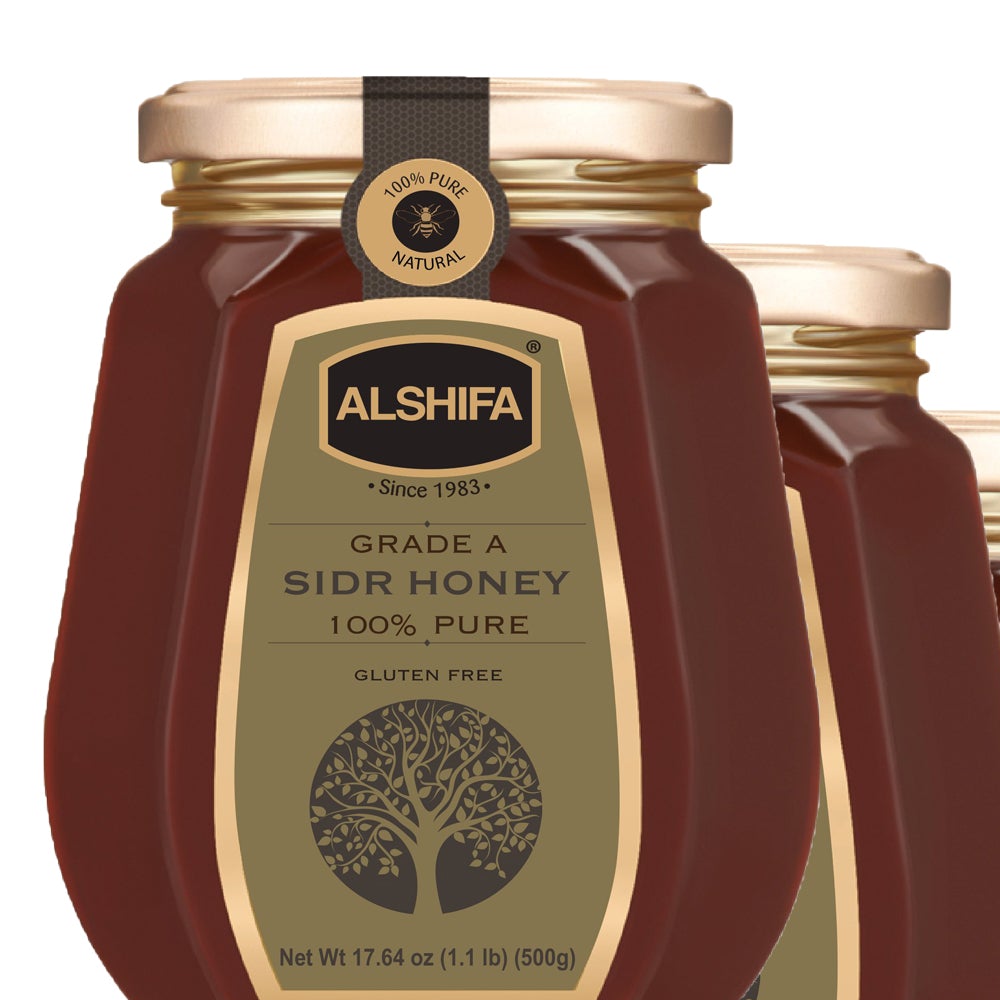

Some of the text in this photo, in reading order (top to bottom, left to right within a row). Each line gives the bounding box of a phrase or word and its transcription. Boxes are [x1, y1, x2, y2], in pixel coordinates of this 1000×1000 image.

[384, 171, 469, 200] 100% PURE
[391, 249, 466, 271] NATURAL
[335, 385, 523, 422] ALSHIFA
[378, 478, 481, 499] Since 1983
[350, 534, 508, 554] GRADE A
[283, 570, 571, 596] SIDR HONEY
[331, 613, 529, 637] 100% PURE
[354, 669, 503, 682] GLUTEN FREE
[279, 947, 576, 972] Net Wt 17.64 oz (1.1 lb) (500g)
